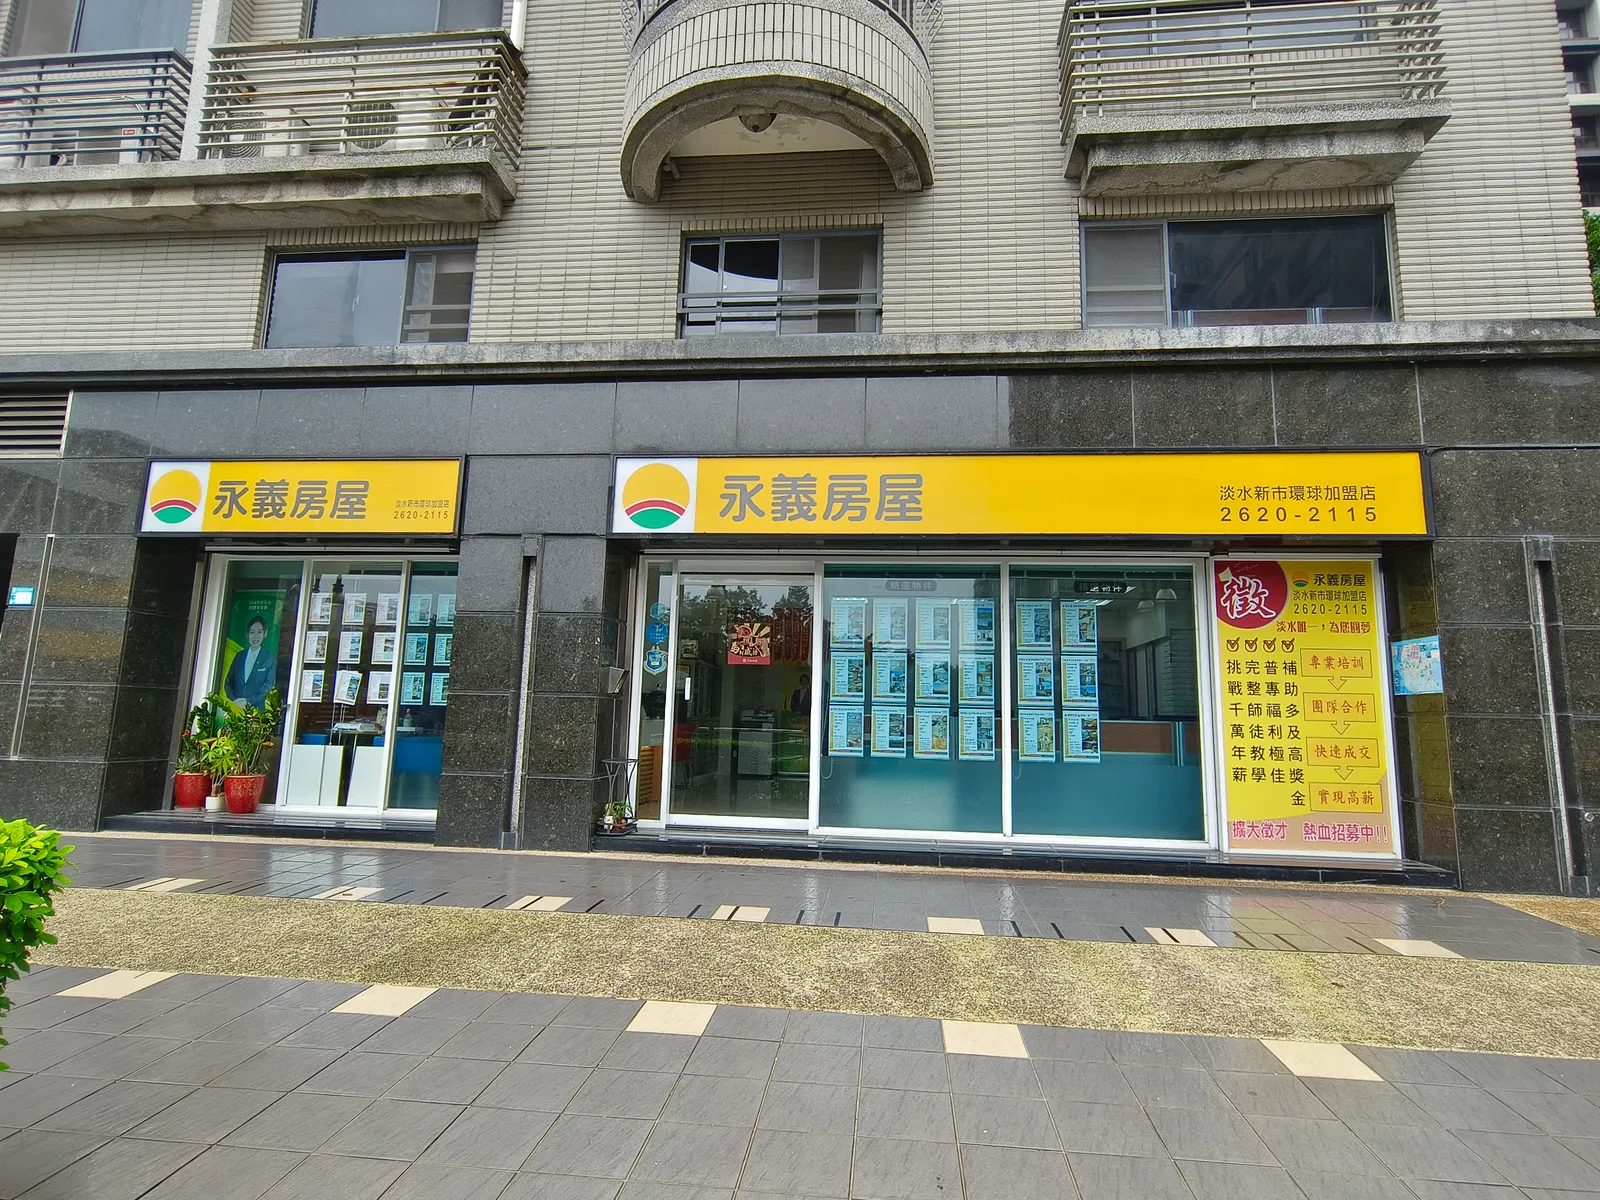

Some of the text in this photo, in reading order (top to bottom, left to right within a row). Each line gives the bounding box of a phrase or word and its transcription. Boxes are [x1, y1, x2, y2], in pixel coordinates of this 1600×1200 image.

[213, 479, 369, 520] 永義房屋
[719, 473, 923, 522] 永義房屋
[1220, 485, 1376, 501] 淡水新市環球加盟店
[393, 510, 449, 520] 2620-2115
[1220, 507, 1377, 522] 2620-2115
[1313, 573, 1367, 587] 永義房屋
[1220, 576, 1276, 620] 徵
[1293, 590, 1367, 602] 淡水新市環球加盟店
[1293, 603, 1368, 615] 2620-2115
[1309, 655, 1364, 670] 專業培訓
[1312, 700, 1367, 714] 團隊合作
[1315, 745, 1371, 760] 快速成交
[1318, 789, 1375, 805] 實現高薪
[1232, 821, 1288, 839] 擴大徵才
[1303, 823, 1388, 843] 熱血招募中!!
